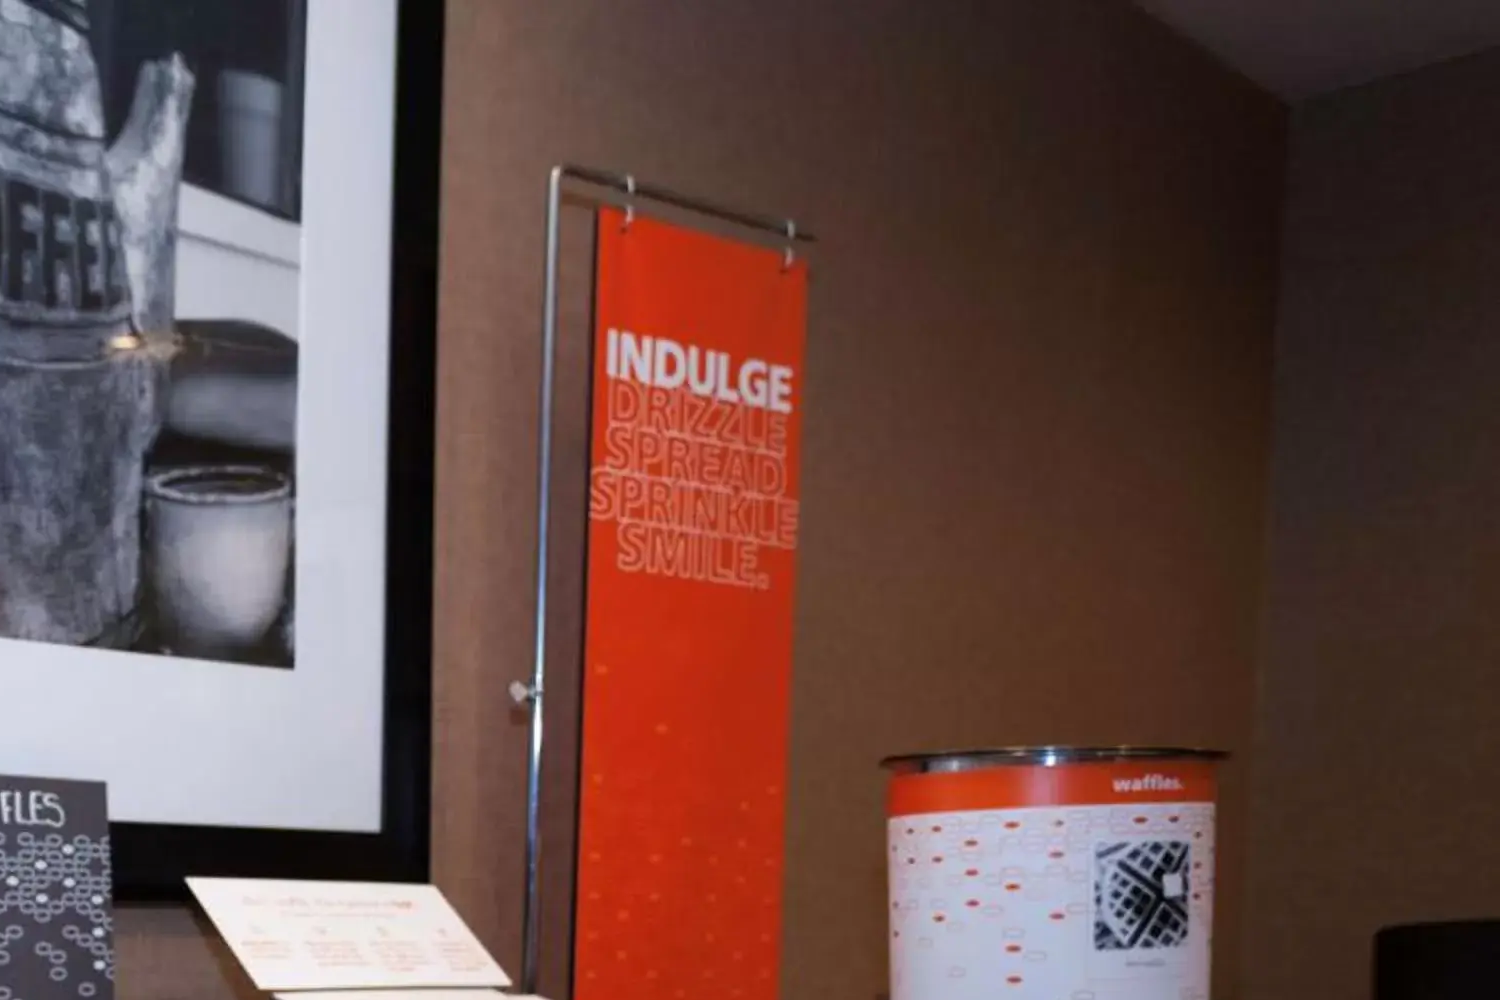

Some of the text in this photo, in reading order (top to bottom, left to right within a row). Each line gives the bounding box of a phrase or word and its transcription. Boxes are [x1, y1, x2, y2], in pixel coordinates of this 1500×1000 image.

[606, 328, 794, 414] INDULGE
[608, 376, 788, 460] DRIZZLE
[605, 424, 787, 499] SPREAD
[589, 464, 799, 549] SPRINKLE
[617, 520, 770, 590] SMILE.
